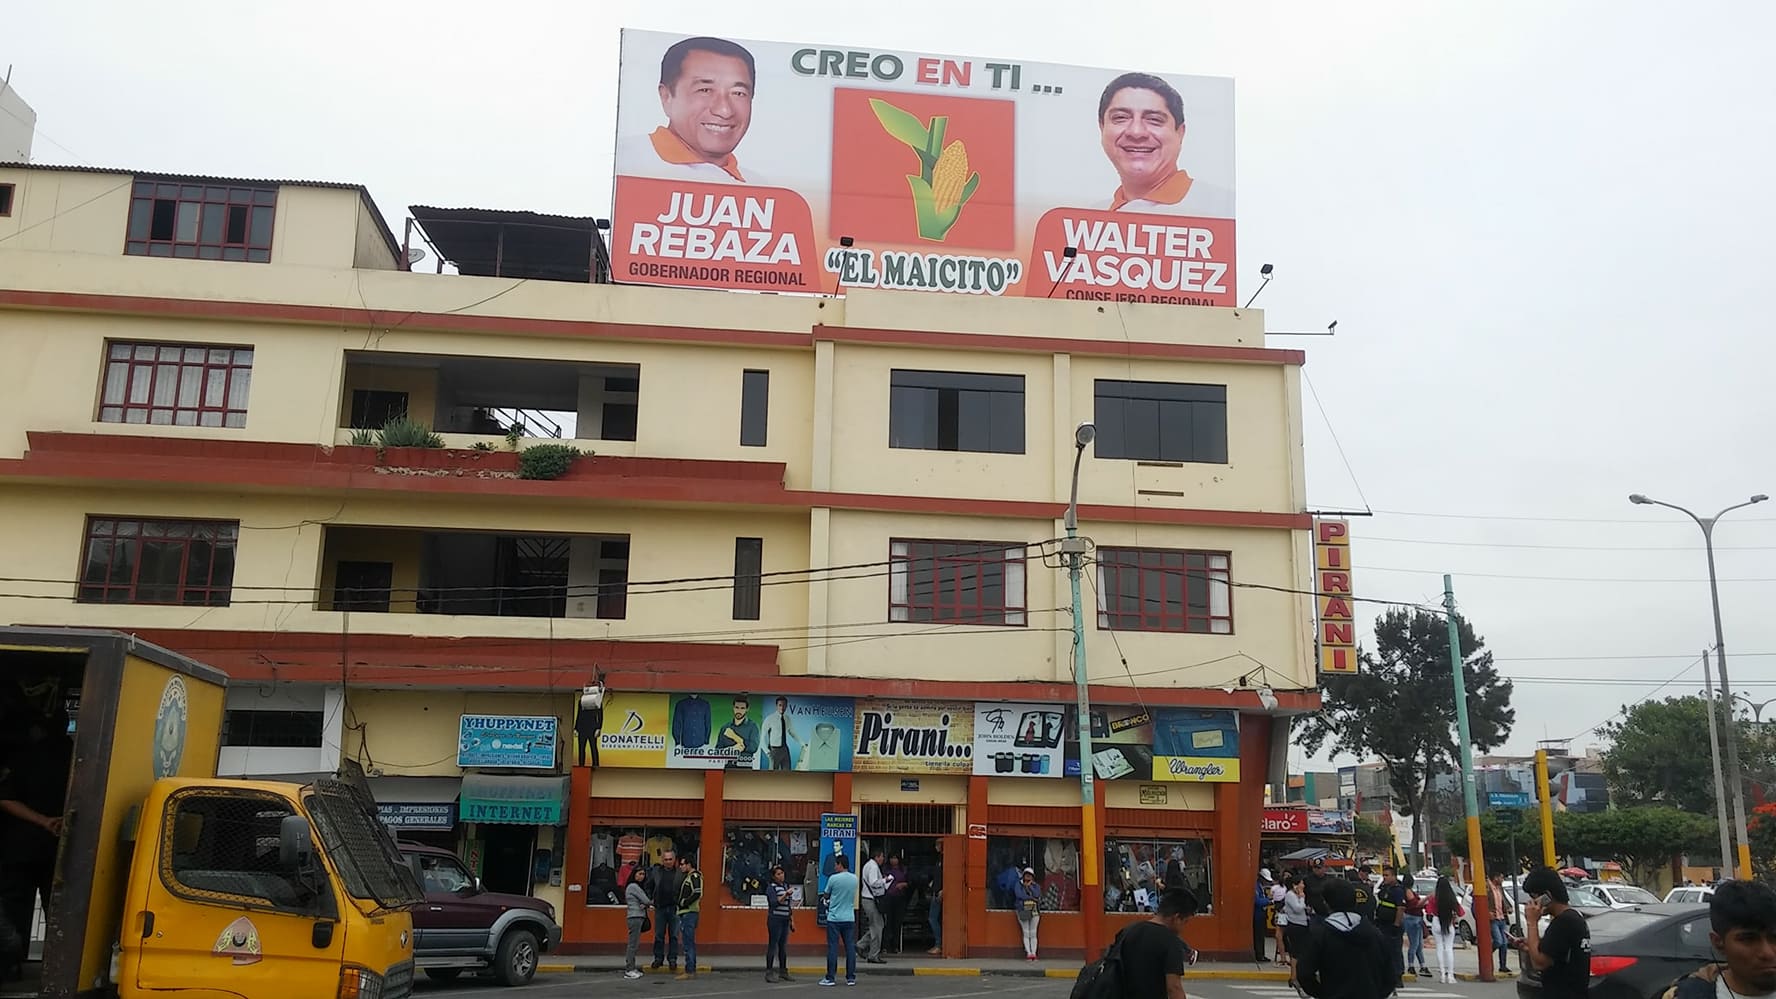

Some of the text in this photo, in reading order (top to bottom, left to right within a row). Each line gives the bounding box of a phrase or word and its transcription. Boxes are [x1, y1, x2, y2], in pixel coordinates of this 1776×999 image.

[788, 48, 904, 80] CREO
[916, 57, 972, 87] EN
[984, 62, 1021, 90] TI
[657, 191, 775, 230] JUAN
[629, 222, 801, 265] REBAZA
[1063, 218, 1214, 259] WALTER
[629, 262, 807, 286] GOBERNADOR REGIONAL
[1043, 251, 1228, 294] VASQUEZ
[1066, 289, 1214, 307] CONSEJERO REGIONAL
[1319, 522, 1353, 670] PIRANI
[465, 718, 554, 731] YHUPPYNET
[857, 713, 972, 758] Pirani...
[601, 734, 664, 745] DONATELLI
[674, 746, 740, 757] pierre cardin
[1170, 758, 1224, 780] Wrangler
[404, 815, 448, 824] GENERALES
[469, 804, 552, 820] INTERNET
[823, 829, 856, 838] PIRANI
